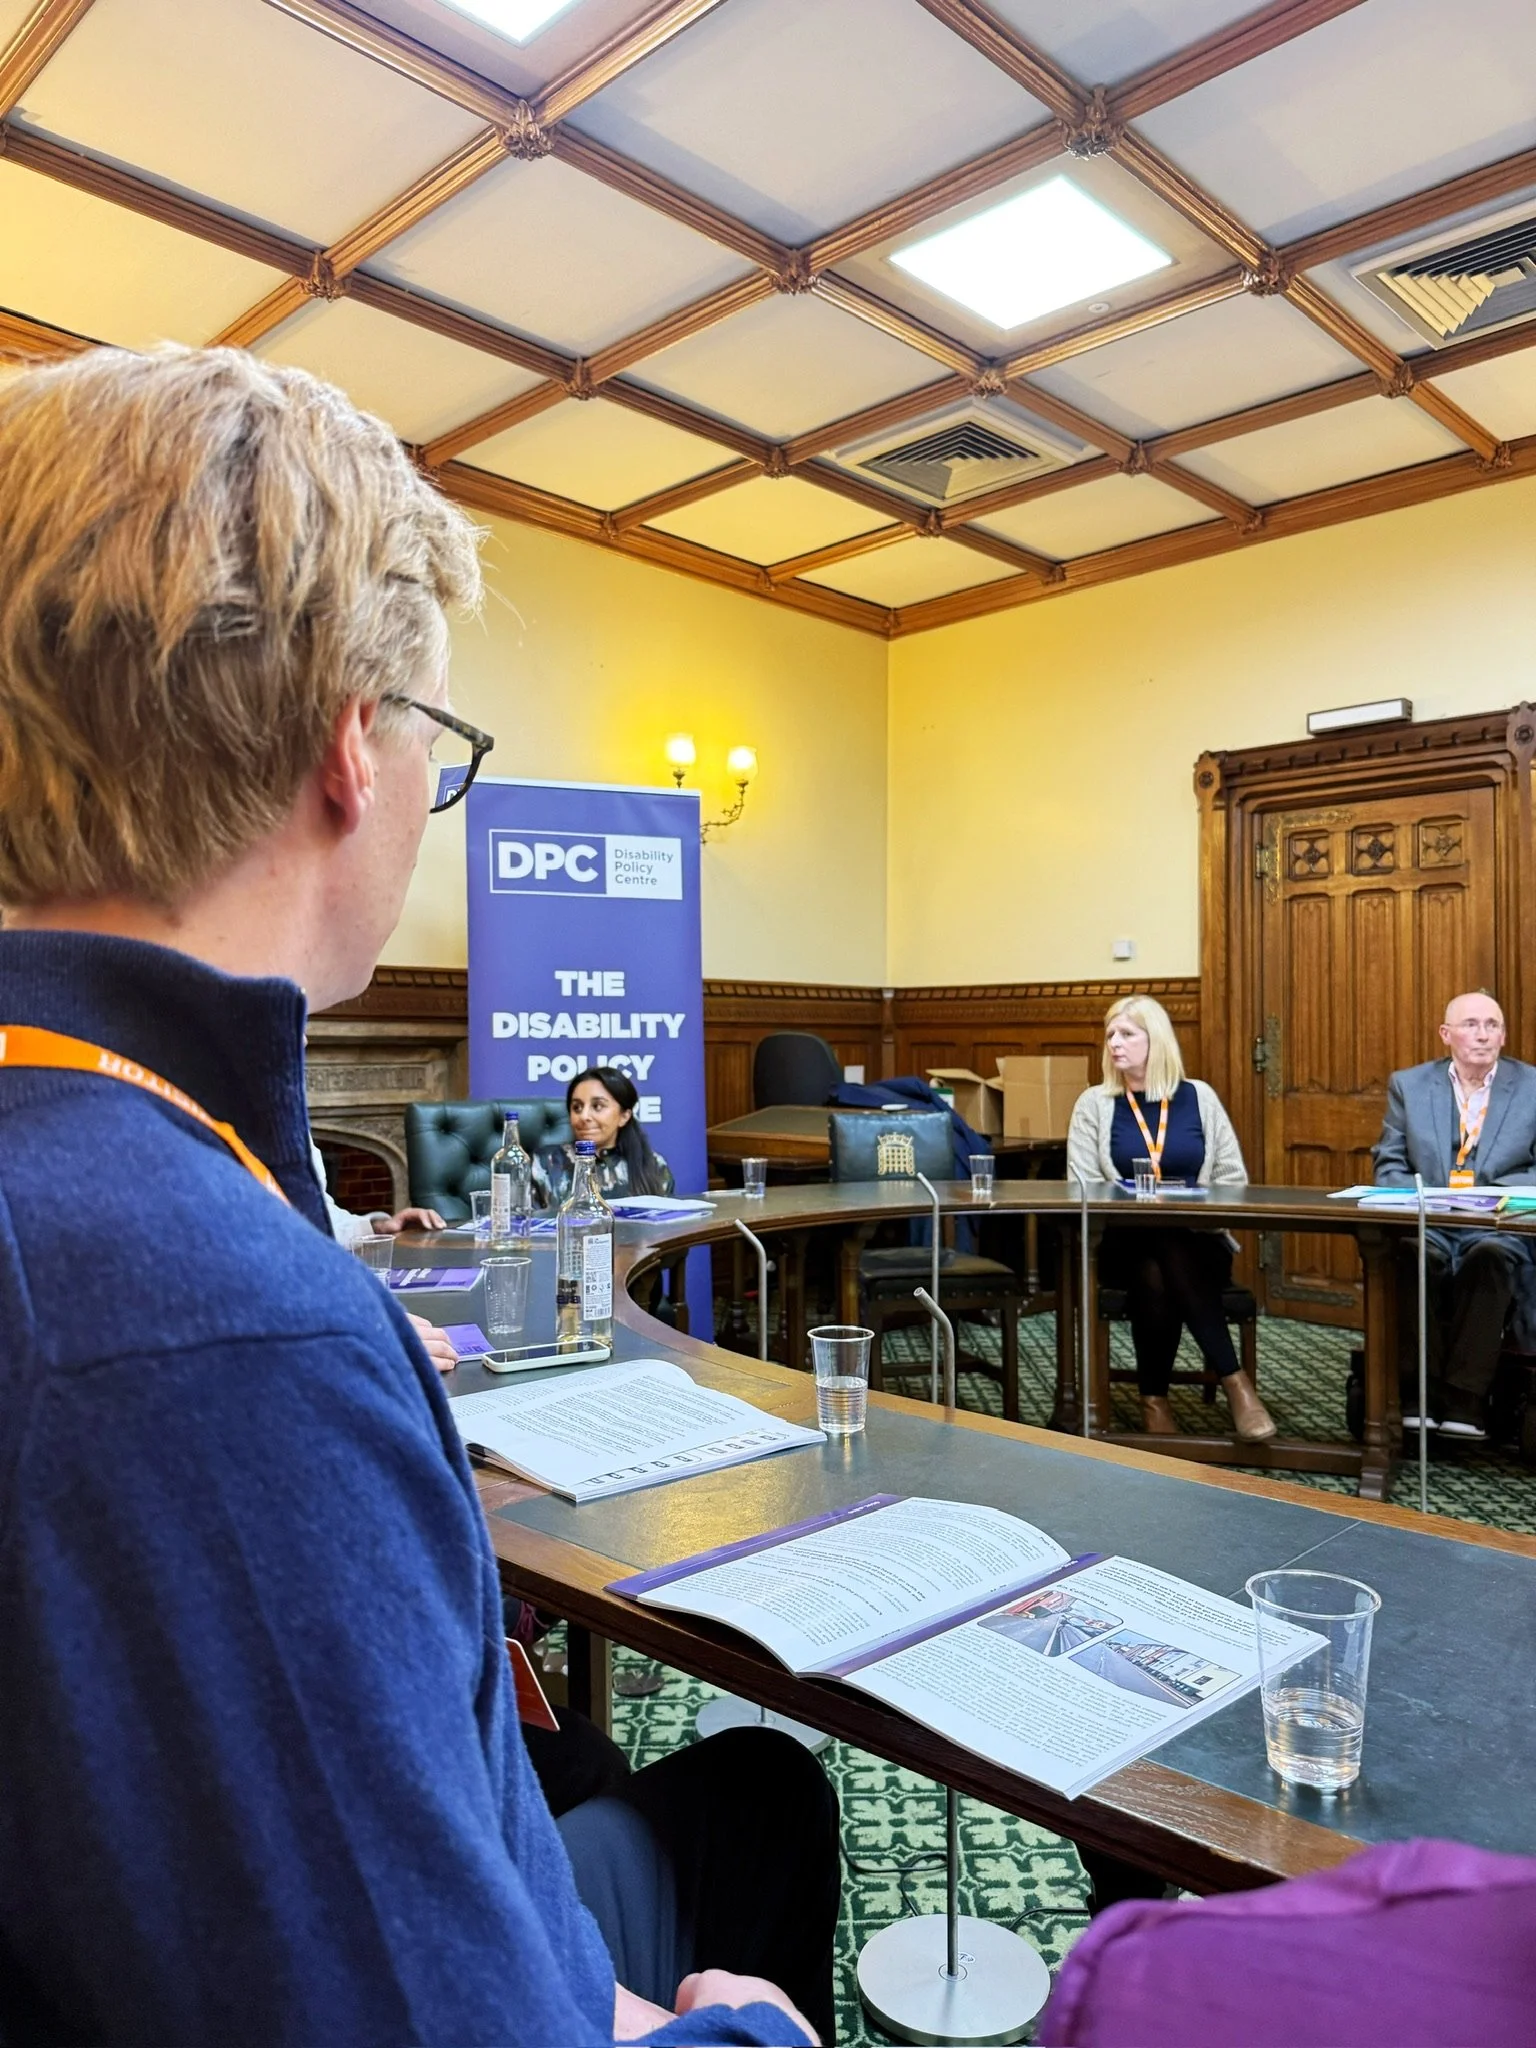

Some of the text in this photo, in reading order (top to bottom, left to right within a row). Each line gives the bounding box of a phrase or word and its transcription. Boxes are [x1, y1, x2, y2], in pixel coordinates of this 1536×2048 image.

[497, 840, 599, 883] DPC
[614, 848, 674, 864] Disability
[614, 861, 654, 875] Policy
[614, 873, 658, 886] Centre
[554, 970, 626, 997] THE
[492, 1011, 686, 1039] DISABILITY
